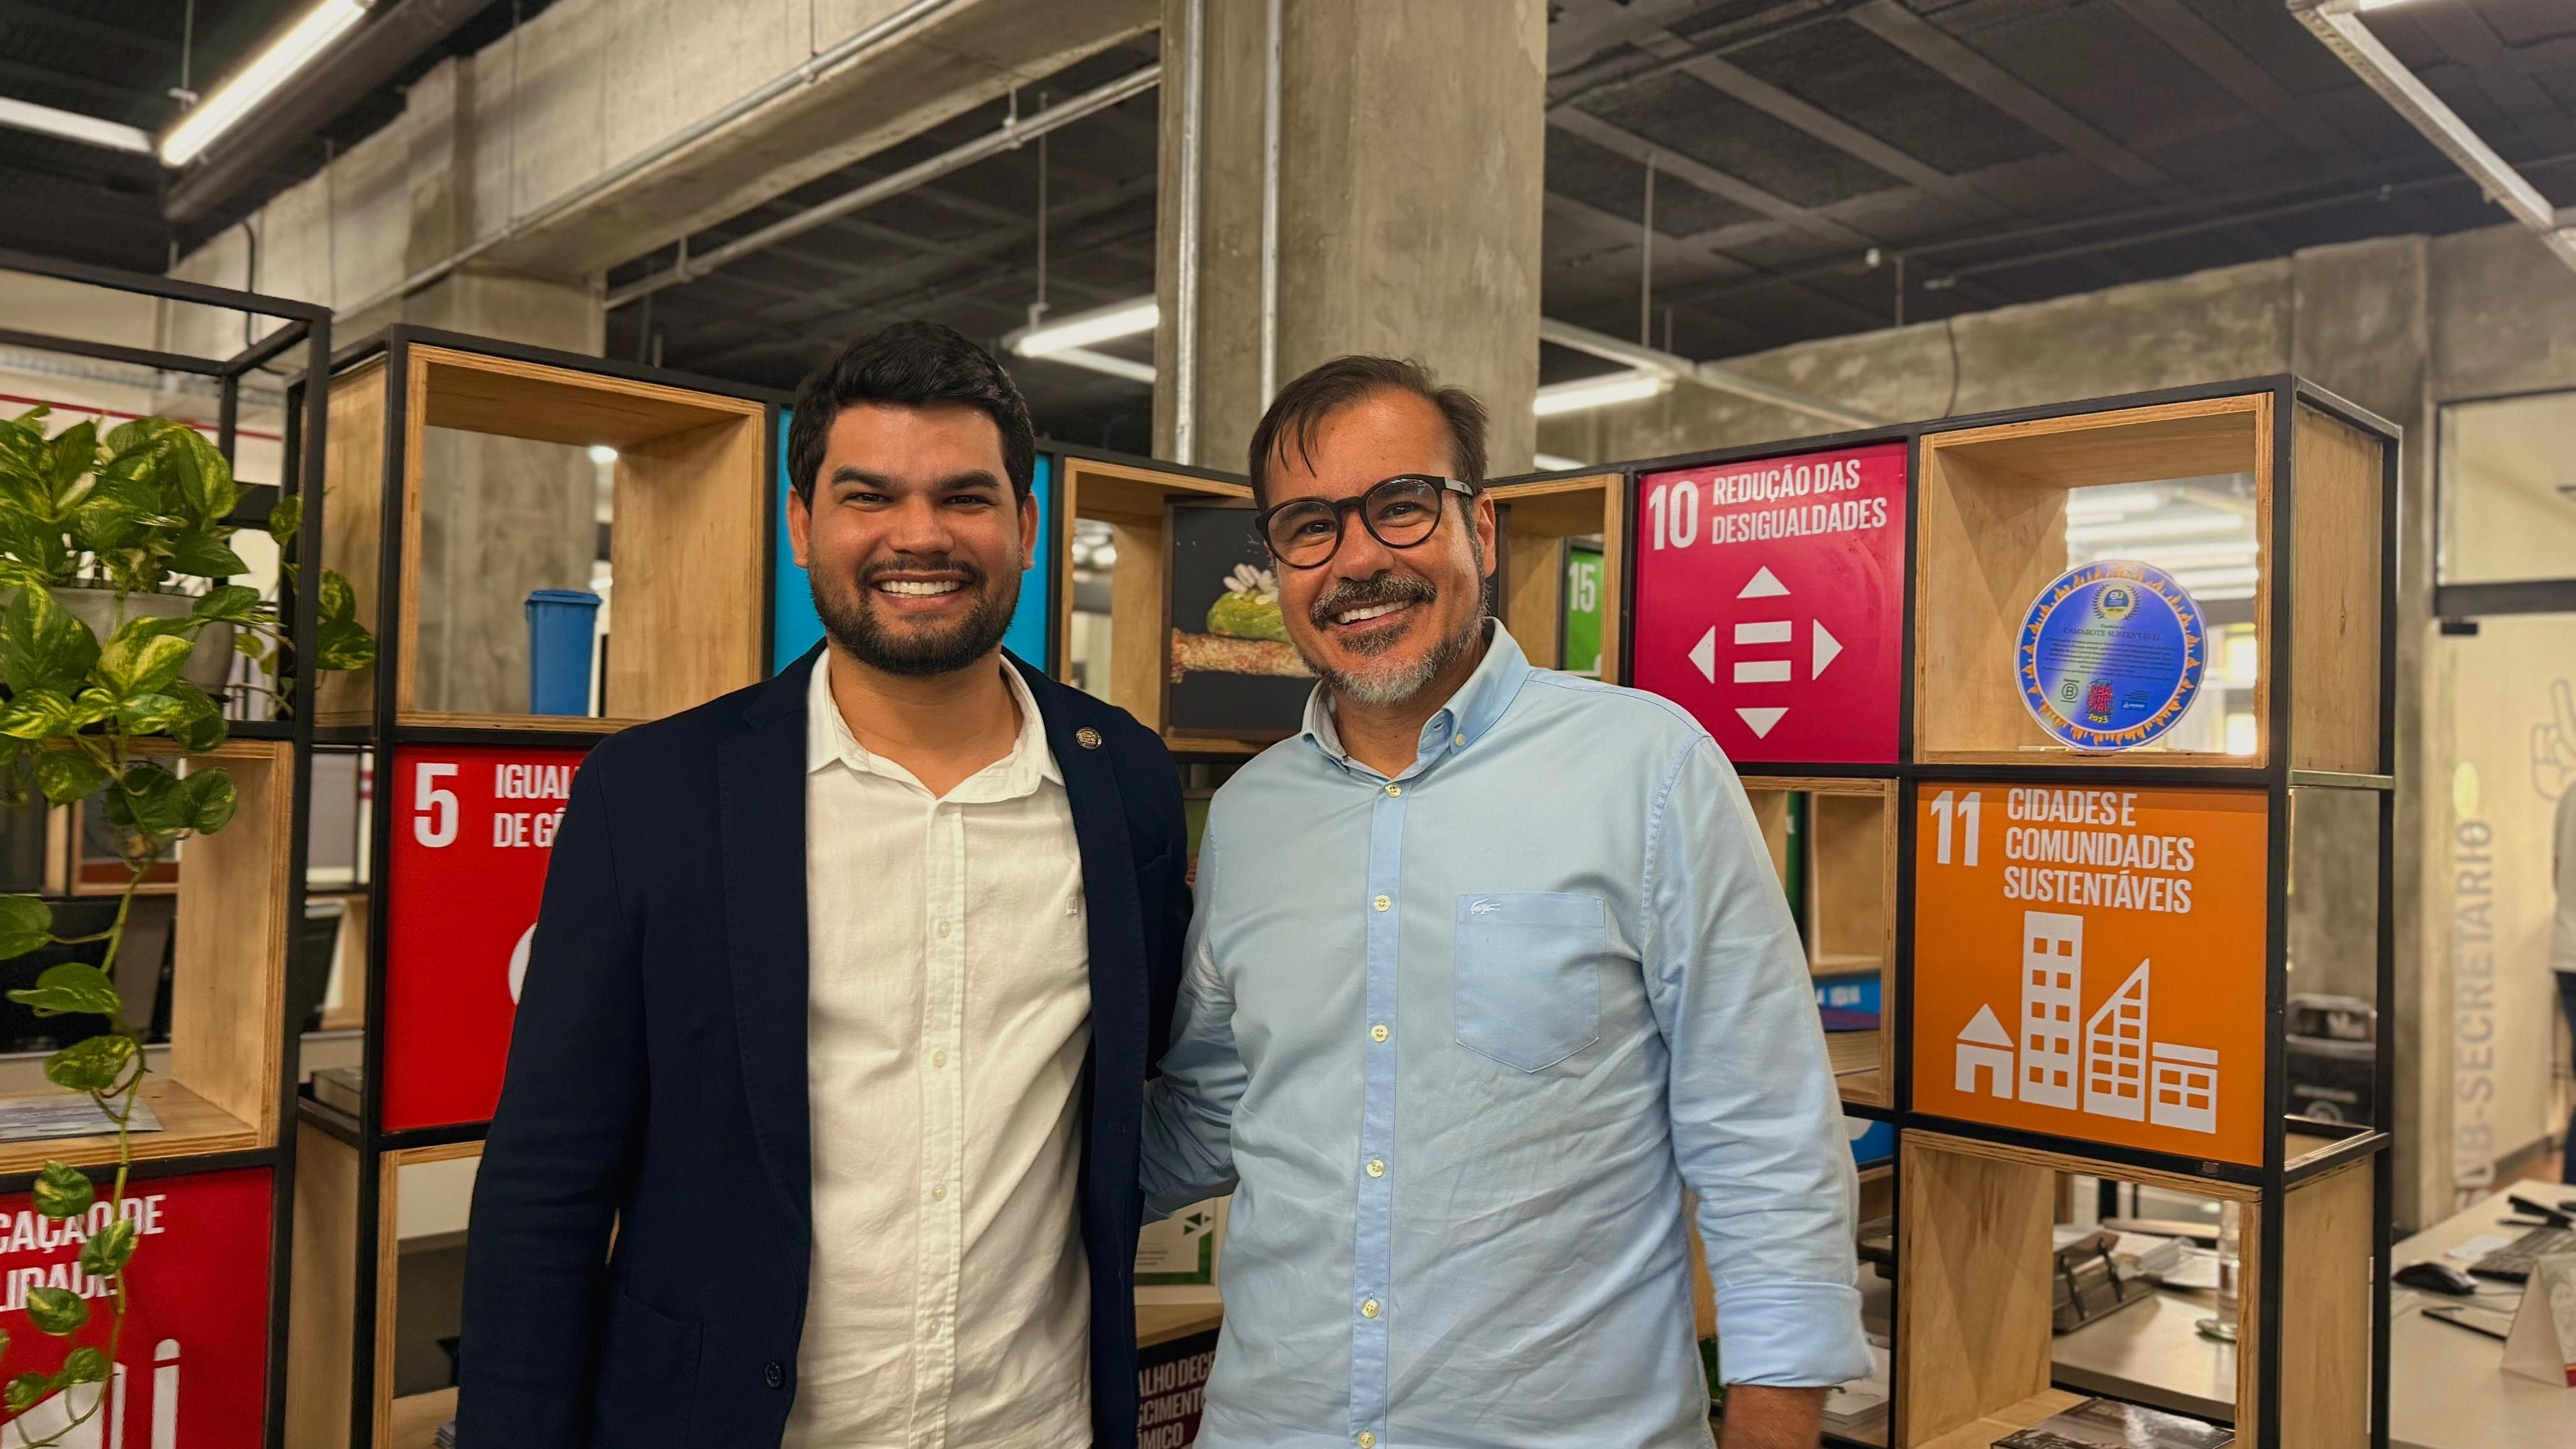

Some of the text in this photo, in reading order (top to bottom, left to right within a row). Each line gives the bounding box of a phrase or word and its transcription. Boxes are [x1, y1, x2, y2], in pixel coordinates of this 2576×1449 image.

[1713, 459, 1861, 505] REDUÇÃO DAS
[1649, 481, 1699, 549] 10
[1712, 497, 1887, 544] DESIGUALDADES
[1569, 562, 1595, 612] 15
[2063, 627, 2163, 640] CAMAROTE SUSTENTÁVEL
[495, 764, 581, 799] IGUAL
[414, 762, 459, 848] 5
[1930, 790, 1982, 866] 11
[2007, 788, 2138, 827] CIDADES E
[493, 813, 531, 848] DE
[2005, 827, 2195, 871] COMUNIDADES
[2003, 866, 2192, 914] SUSTENTÁVEIS
[120, 1194, 167, 1235] DE
